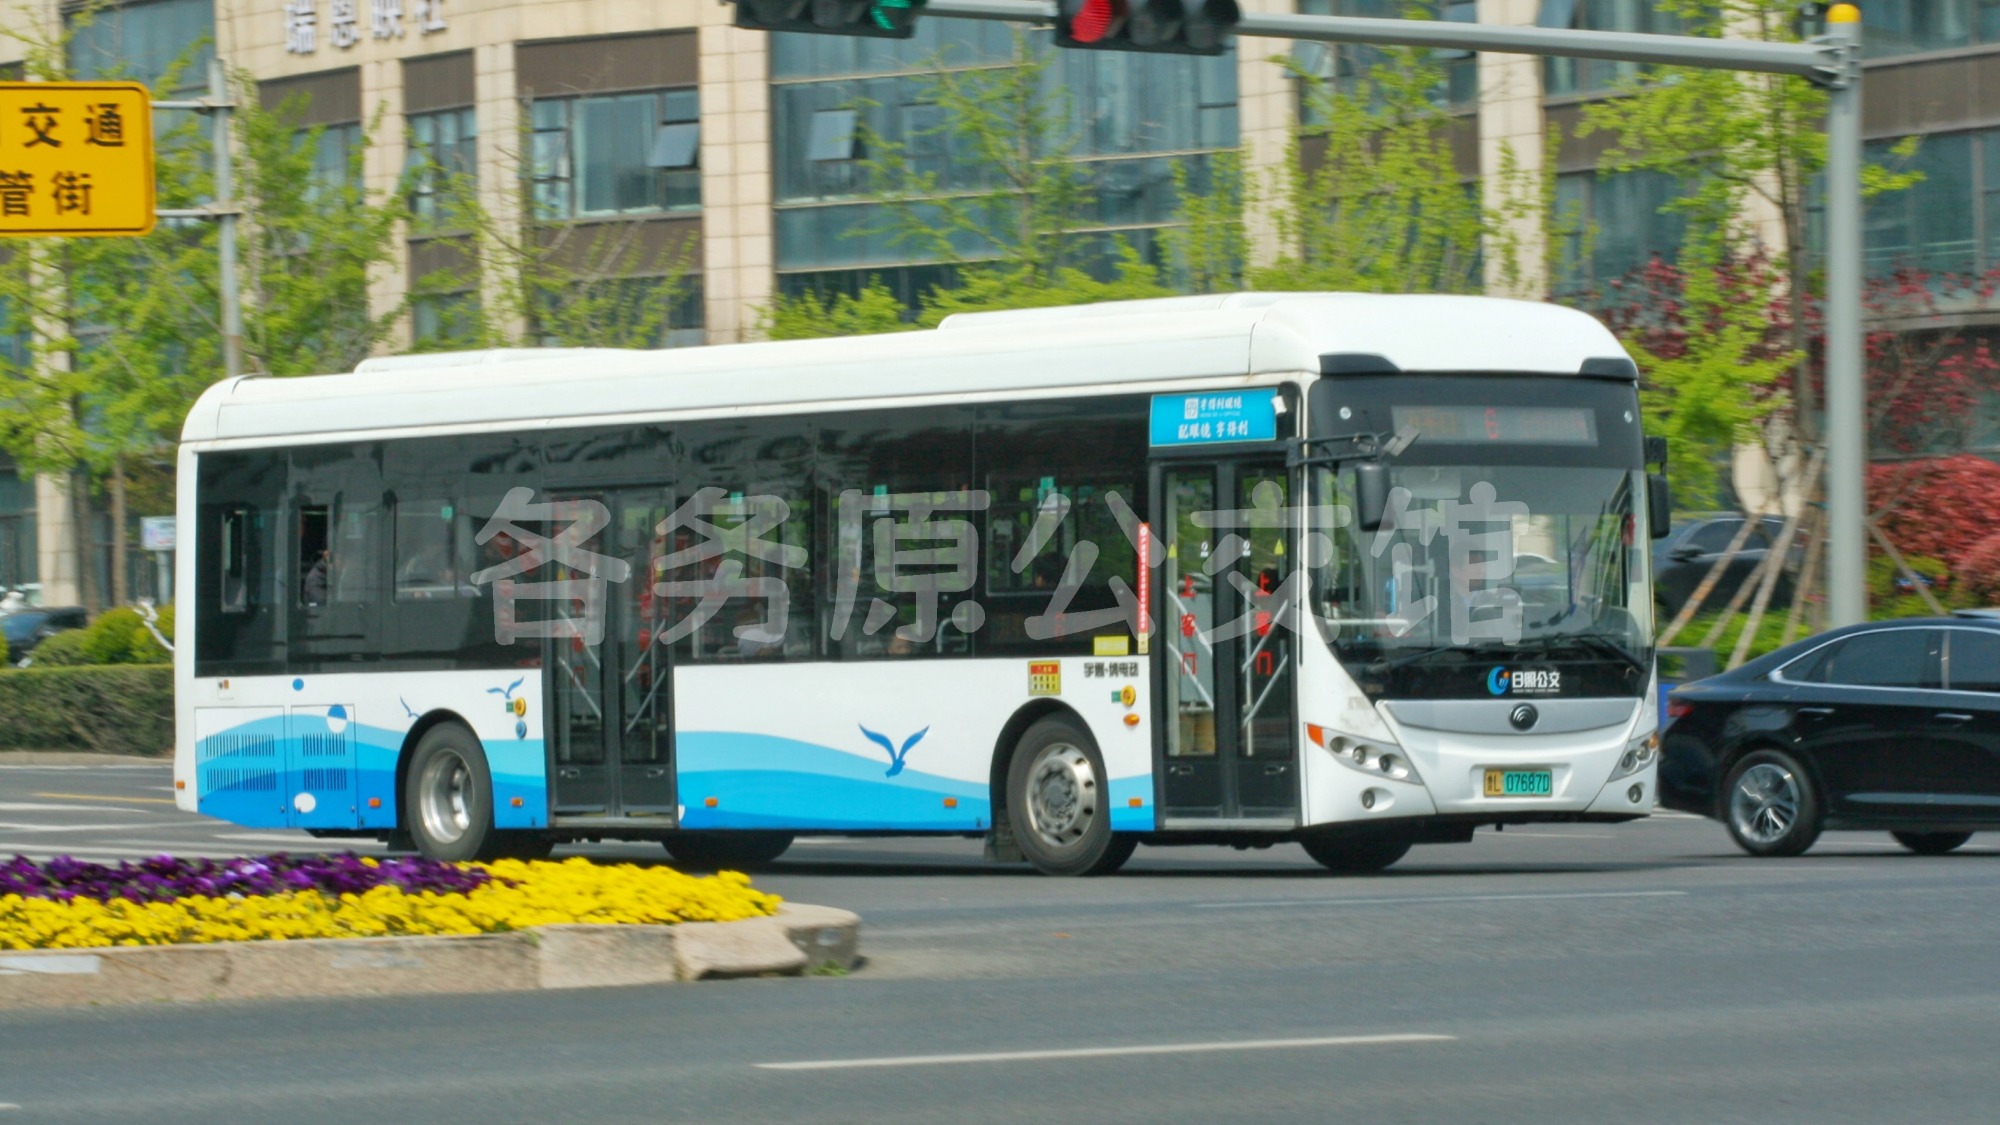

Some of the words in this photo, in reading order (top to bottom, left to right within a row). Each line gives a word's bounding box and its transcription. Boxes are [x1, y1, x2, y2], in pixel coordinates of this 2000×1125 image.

[20, 102, 125, 148] 交通
[1484, 407, 1498, 440] 6
[1512, 671, 1560, 688] 日照公交
